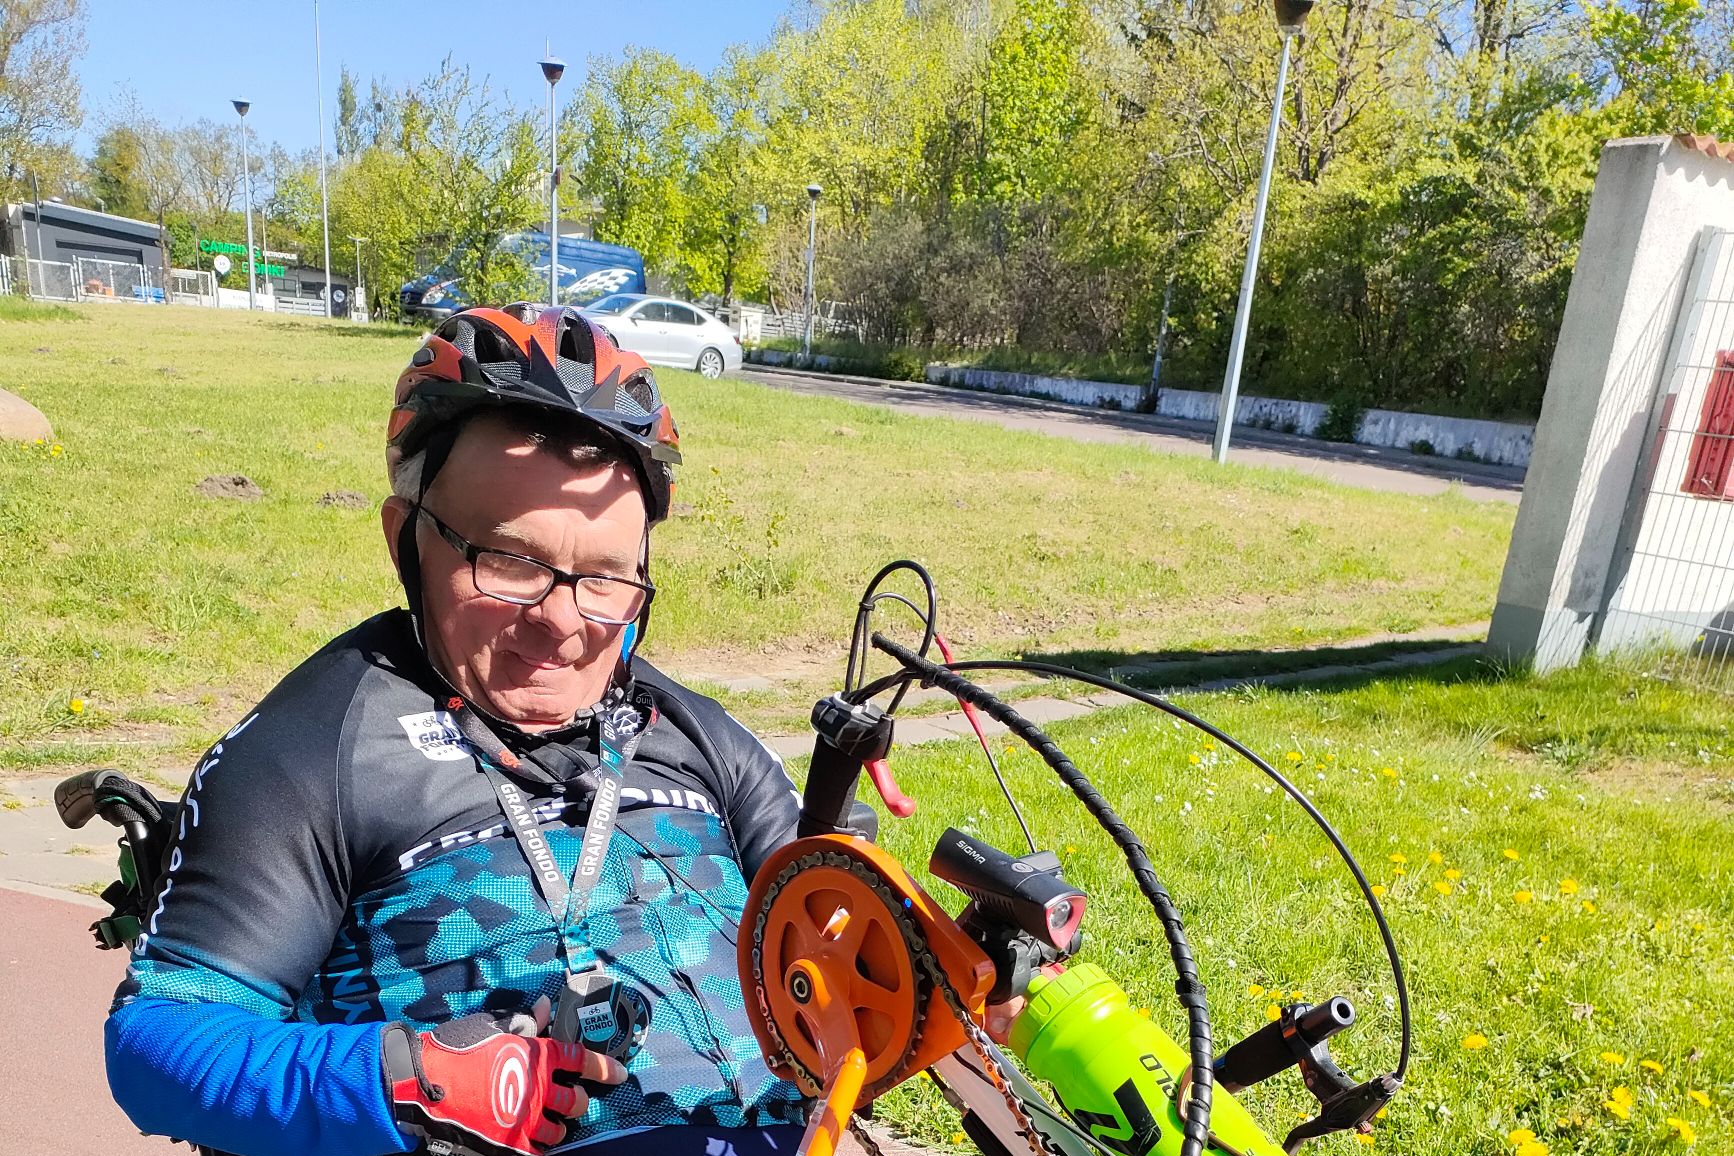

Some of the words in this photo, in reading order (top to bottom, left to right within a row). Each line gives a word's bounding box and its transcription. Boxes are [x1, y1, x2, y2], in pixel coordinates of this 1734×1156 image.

[500, 783, 531, 826] GRAN
[522, 828, 560, 882] FONDO
[581, 832, 605, 876] GRAN
[593, 777, 617, 833] FONDO
[956, 840, 986, 865] SIGMA
[583, 1020, 614, 1033] FONDO
[584, 1013, 609, 1026] GRAN
